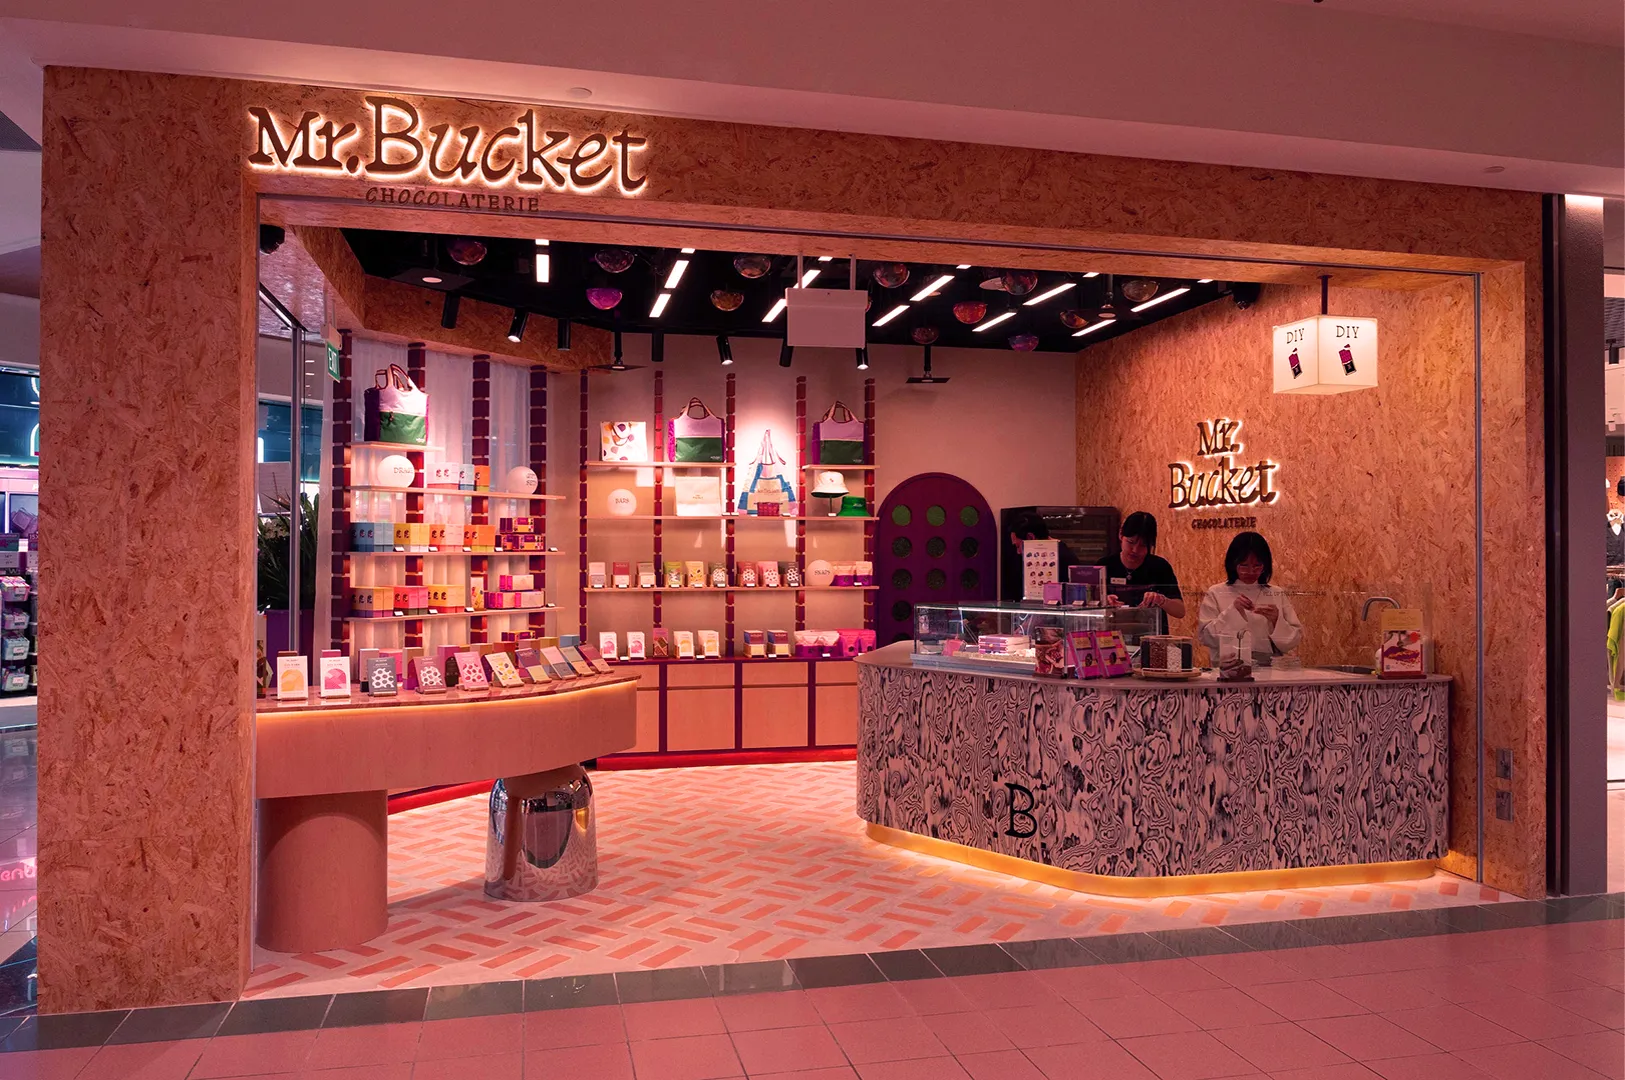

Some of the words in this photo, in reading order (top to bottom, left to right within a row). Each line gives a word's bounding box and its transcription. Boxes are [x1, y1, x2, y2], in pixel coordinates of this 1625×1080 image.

[365, 186, 541, 213] CHOCOLATERIE
[1286, 328, 1305, 344] DIY
[1335, 325, 1360, 338] DIY
[1197, 418, 1244, 455] Mr.
[1168, 456, 1278, 508] Bucket
[1191, 516, 1257, 529] CHOCOLATERIE
[1004, 782, 1038, 839] B
